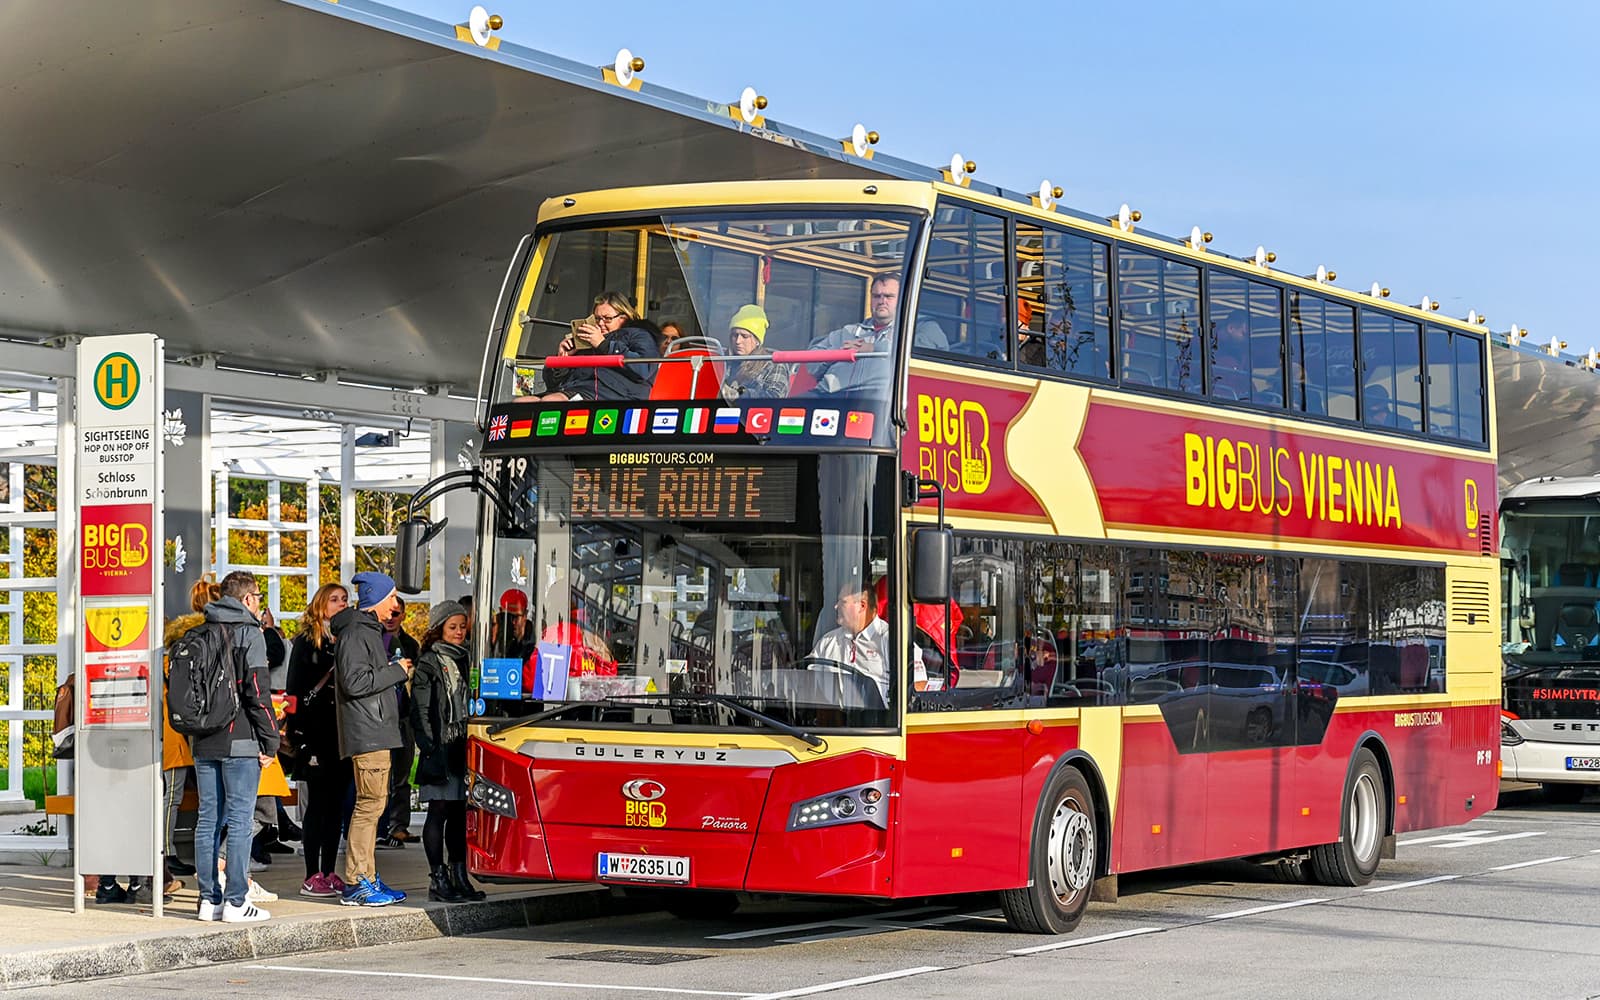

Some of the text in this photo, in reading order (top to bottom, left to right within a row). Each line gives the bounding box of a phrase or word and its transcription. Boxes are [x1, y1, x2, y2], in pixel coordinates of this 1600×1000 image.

[106, 363, 128, 398] H
[918, 394, 959, 446] BIG
[84, 429, 149, 442] SIGHTSEEING
[84, 441, 149, 453] HOP ON HOP OFF
[99, 453, 135, 463] BUSSTOP
[609, 452, 714, 465] BIGBUSTOURS.COM
[98, 471, 136, 483] Schloss
[484, 457, 527, 480] PF 19
[919, 446, 960, 493] BUS
[85, 487, 148, 499] Schönbrunn
[571, 467, 764, 518] BLUE ROUTE
[1299, 451, 1402, 529] VIENNA
[84, 524, 120, 547] BIG
[84, 547, 120, 569] BUS
[111, 617, 122, 641] 3
[543, 653, 565, 695] T
[626, 801, 649, 814] BIG
[626, 814, 649, 827] BUS
[701, 815, 748, 830] Panora
[609, 857, 619, 873] W
